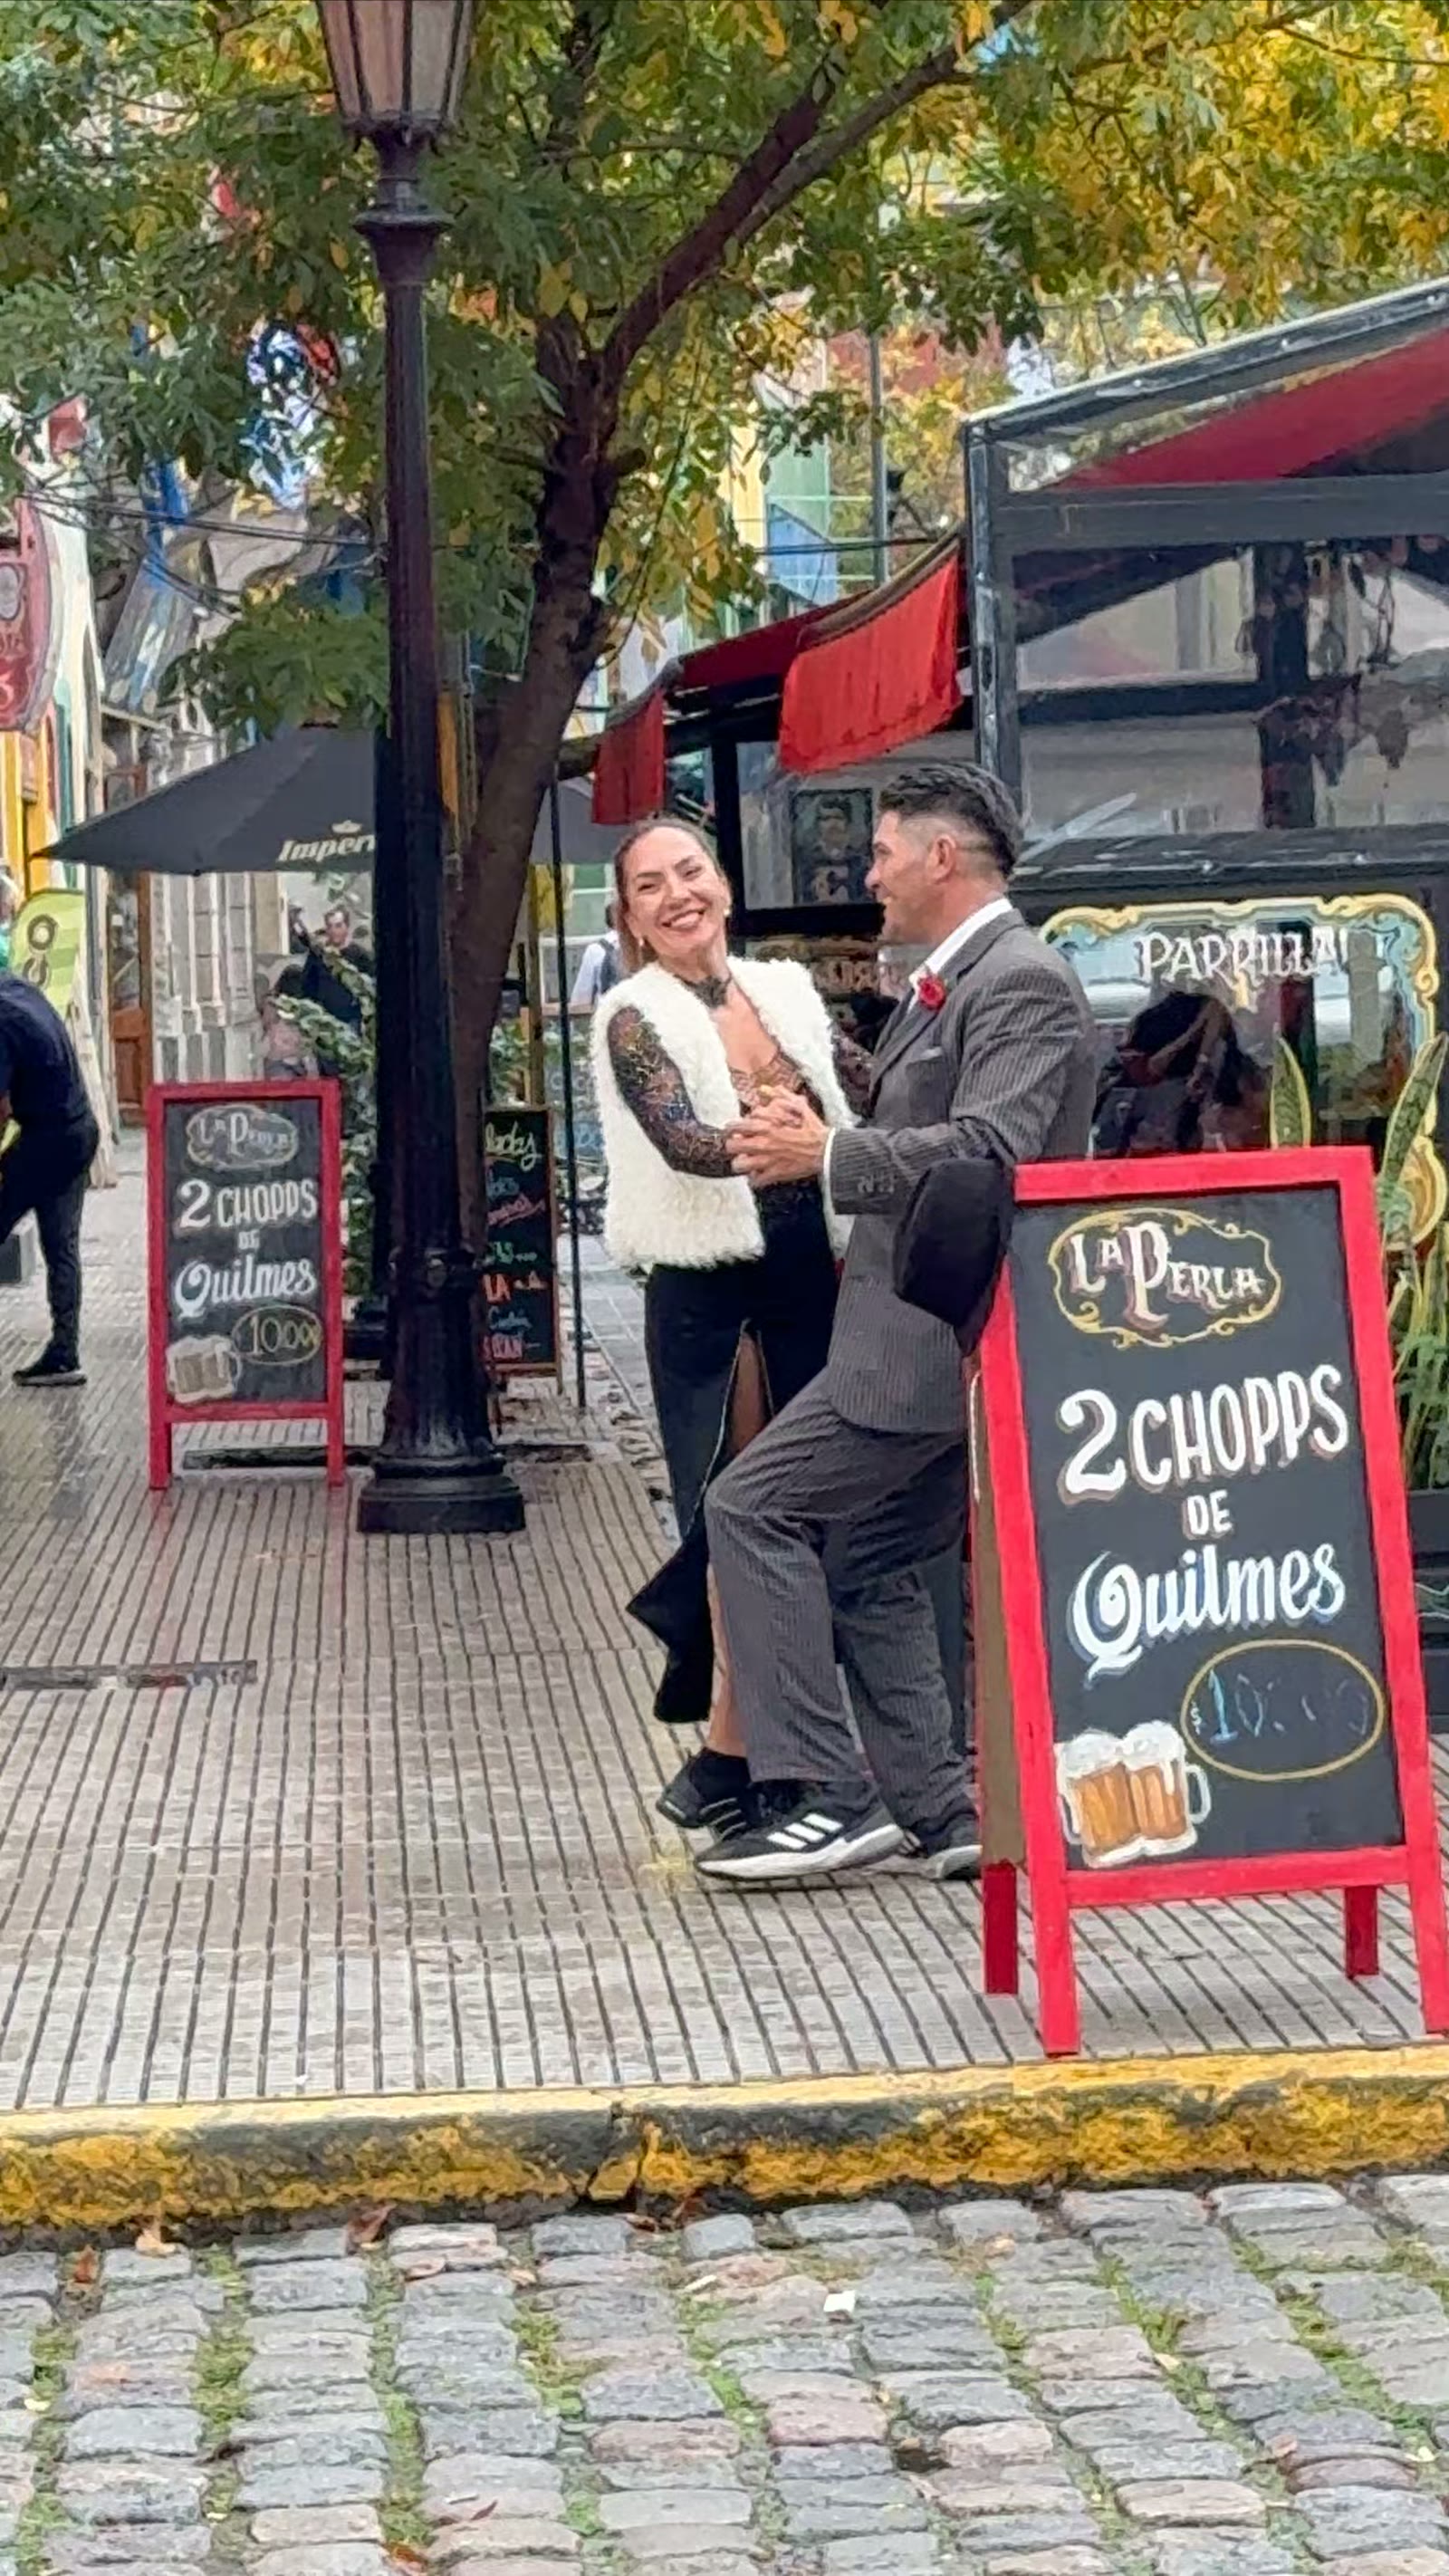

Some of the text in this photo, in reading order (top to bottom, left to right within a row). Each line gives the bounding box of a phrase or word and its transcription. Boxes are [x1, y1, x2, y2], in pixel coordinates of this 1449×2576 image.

[1134, 929, 1341, 989] PARRILLA
[178, 1177, 319, 1231] 2 CHOPPS
[174, 1254, 317, 1322] Quilmes
[1067, 1219, 1269, 1330] LA PERLA
[1058, 1363, 1348, 1502] 2 CHOPPS
[1184, 1489, 1233, 1539] DE
[1069, 1543, 1346, 1683] Quilmes
